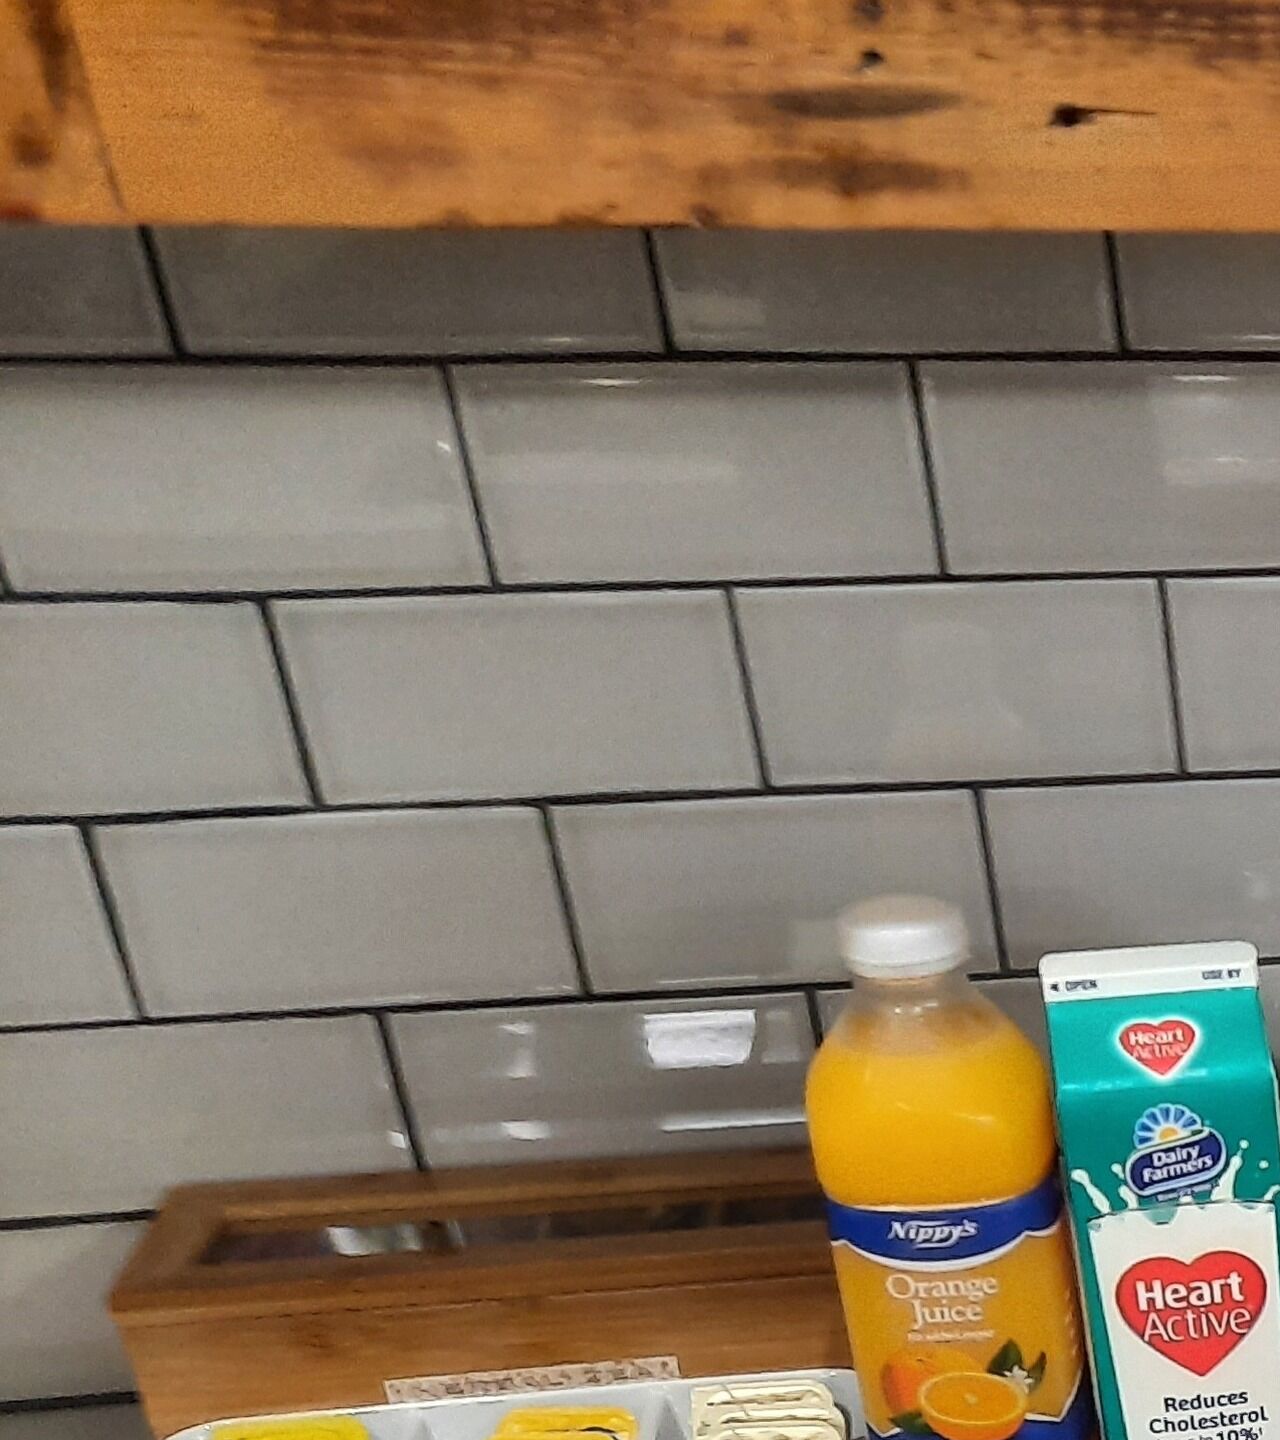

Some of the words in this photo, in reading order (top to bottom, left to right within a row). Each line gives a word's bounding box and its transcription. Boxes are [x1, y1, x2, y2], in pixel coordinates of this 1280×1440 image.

[1128, 1028, 1184, 1046] Heart
[1143, 1155, 1213, 1183] Farmers
[1152, 1143, 1201, 1167] Dairy
[888, 1219, 979, 1247] Nippy's
[886, 1274, 999, 1300] Orange
[1135, 1272, 1244, 1312] Heart
[911, 1300, 984, 1330] Juice
[1143, 1307, 1251, 1342] Active
[1163, 1391, 1248, 1413] Reduces
[1149, 1406, 1269, 1434] Cholesterol
